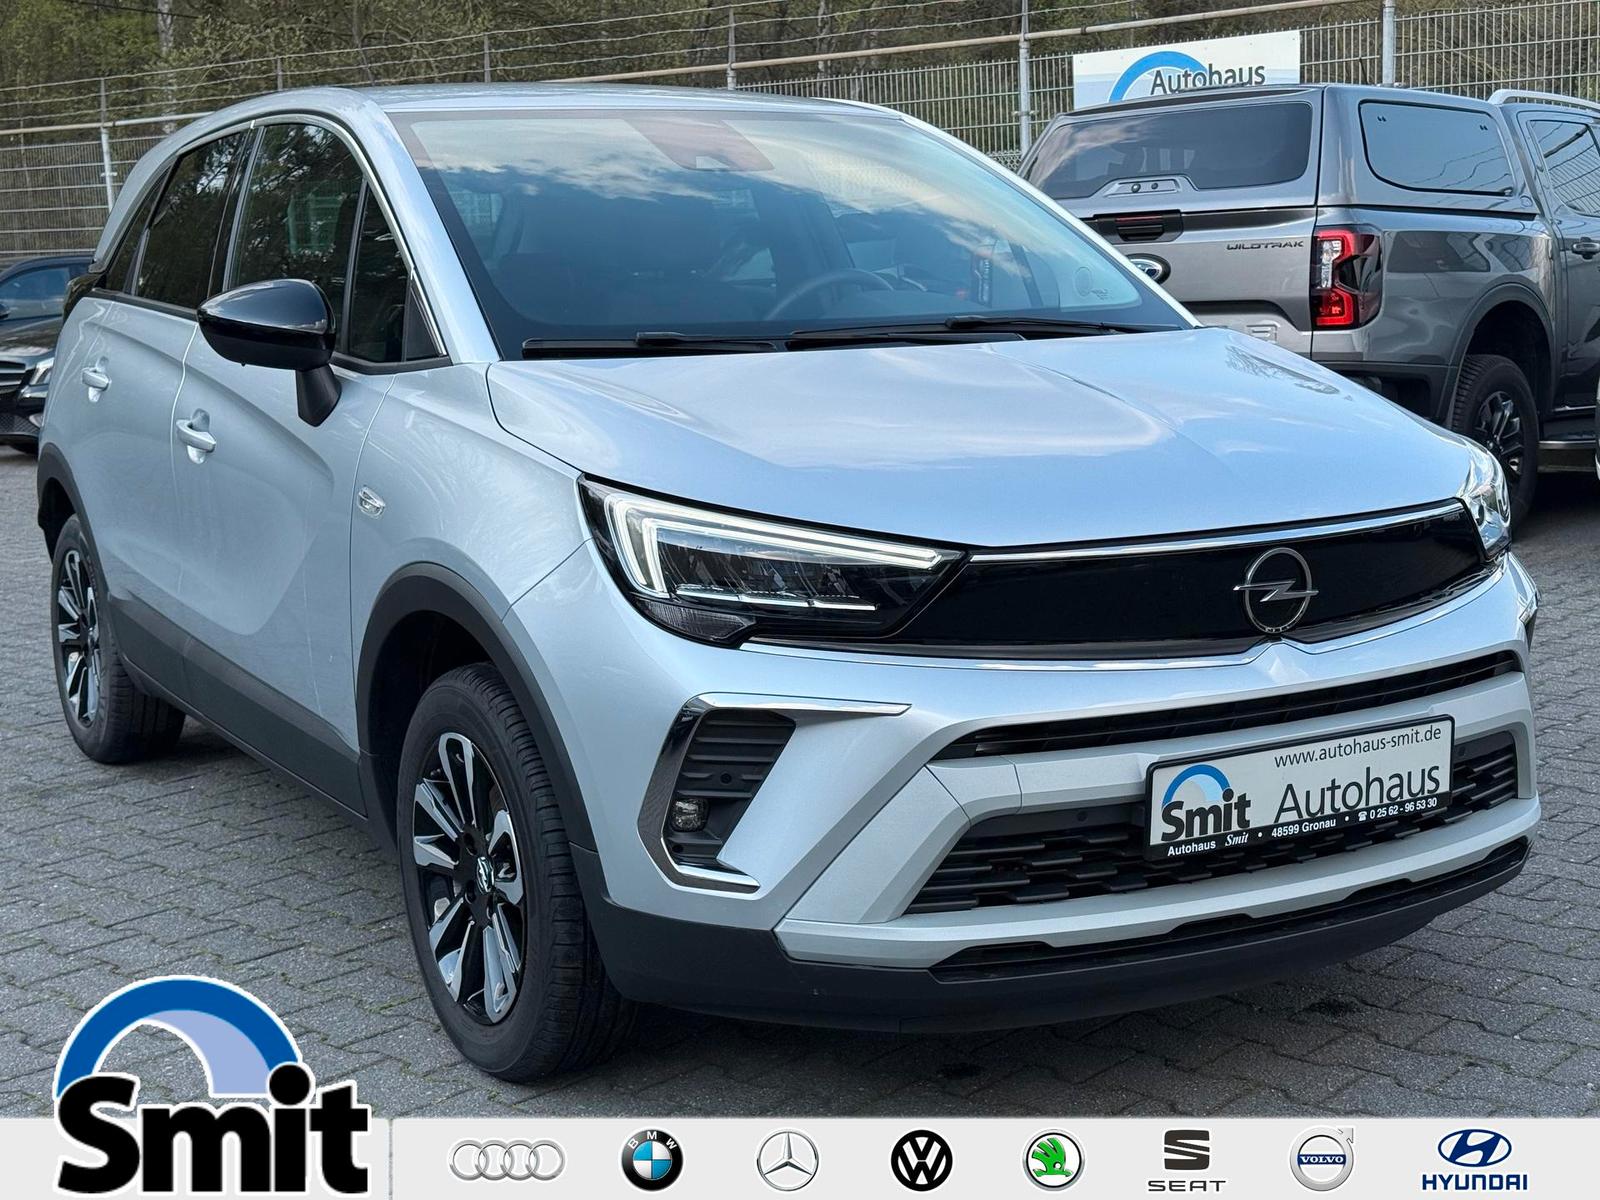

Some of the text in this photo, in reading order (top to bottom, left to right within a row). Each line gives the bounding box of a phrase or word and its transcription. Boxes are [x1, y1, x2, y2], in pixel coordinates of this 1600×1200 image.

[1150, 63, 1265, 95] Autohaus
[1226, 240, 1304, 251] WILDTRAK
[1274, 725, 1442, 768] www.autohaus-smit.de
[1160, 788, 1251, 842] Smit
[1273, 765, 1441, 824] Autohaus
[1167, 840, 1217, 857] Autohaus
[1224, 831, 1250, 847] Smit
[1271, 823, 1300, 838] 48599
[1301, 818, 1337, 833] Gronau
